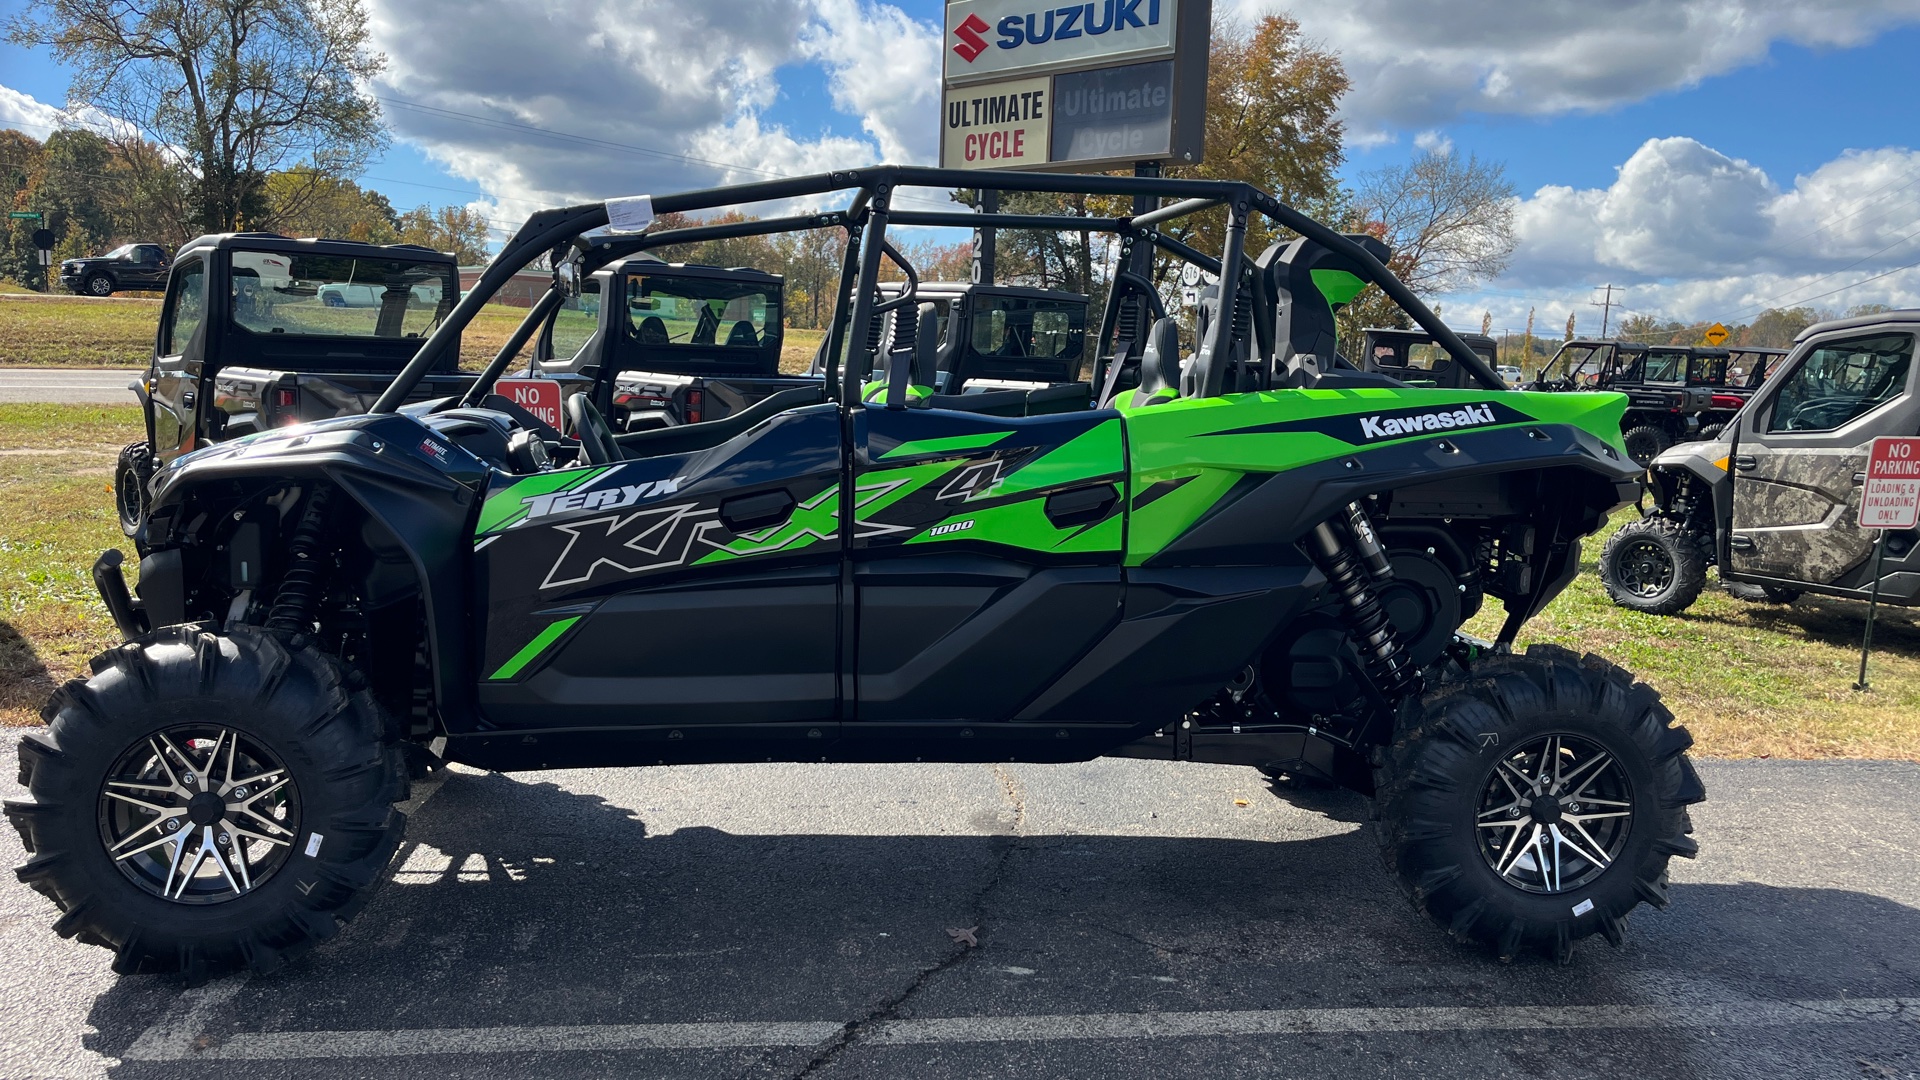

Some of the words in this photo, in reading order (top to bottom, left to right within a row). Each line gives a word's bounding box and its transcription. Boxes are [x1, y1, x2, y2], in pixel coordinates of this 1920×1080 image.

[997, 0, 1160, 50] SUZUKI
[1064, 81, 1167, 117] Ultimate
[949, 90, 1044, 129] ULTIMATE
[964, 129, 1025, 162] CYCLE
[1079, 124, 1144, 155] Cycle
[1184, 266, 1198, 280] 676
[515, 387, 540, 405] NO
[619, 385, 640, 393] RIDGE
[1359, 403, 1496, 439] Kawasaki
[1888, 443, 1911, 459] NO
[1873, 460, 1920, 475] PARKING
[935, 459, 1005, 504] 4
[1870, 483, 1906, 494] LOADING
[1908, 483, 1916, 494] &
[522, 475, 688, 519] TERYX
[1867, 497, 1915, 507] UNLOADING
[1877, 509, 1901, 520] ONLY
[929, 519, 976, 537] 1000
